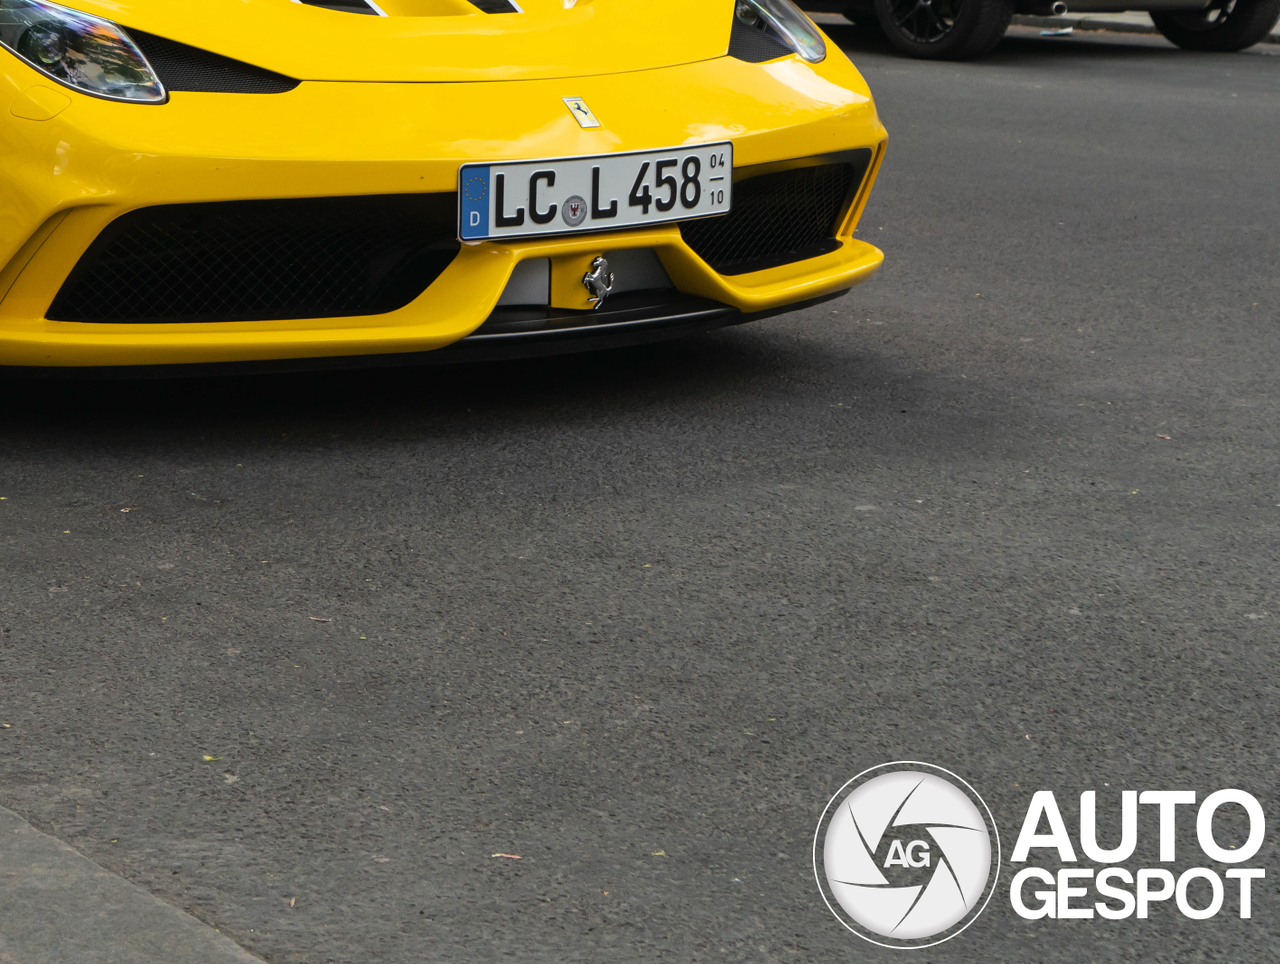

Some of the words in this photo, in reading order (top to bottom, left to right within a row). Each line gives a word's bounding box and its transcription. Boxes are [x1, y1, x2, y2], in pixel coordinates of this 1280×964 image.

[709, 152, 726, 169] 04
[469, 211, 481, 227] D
[495, 169, 558, 228] LC
[591, 165, 618, 220] L
[628, 154, 702, 216] 458
[709, 189, 725, 206] 10
